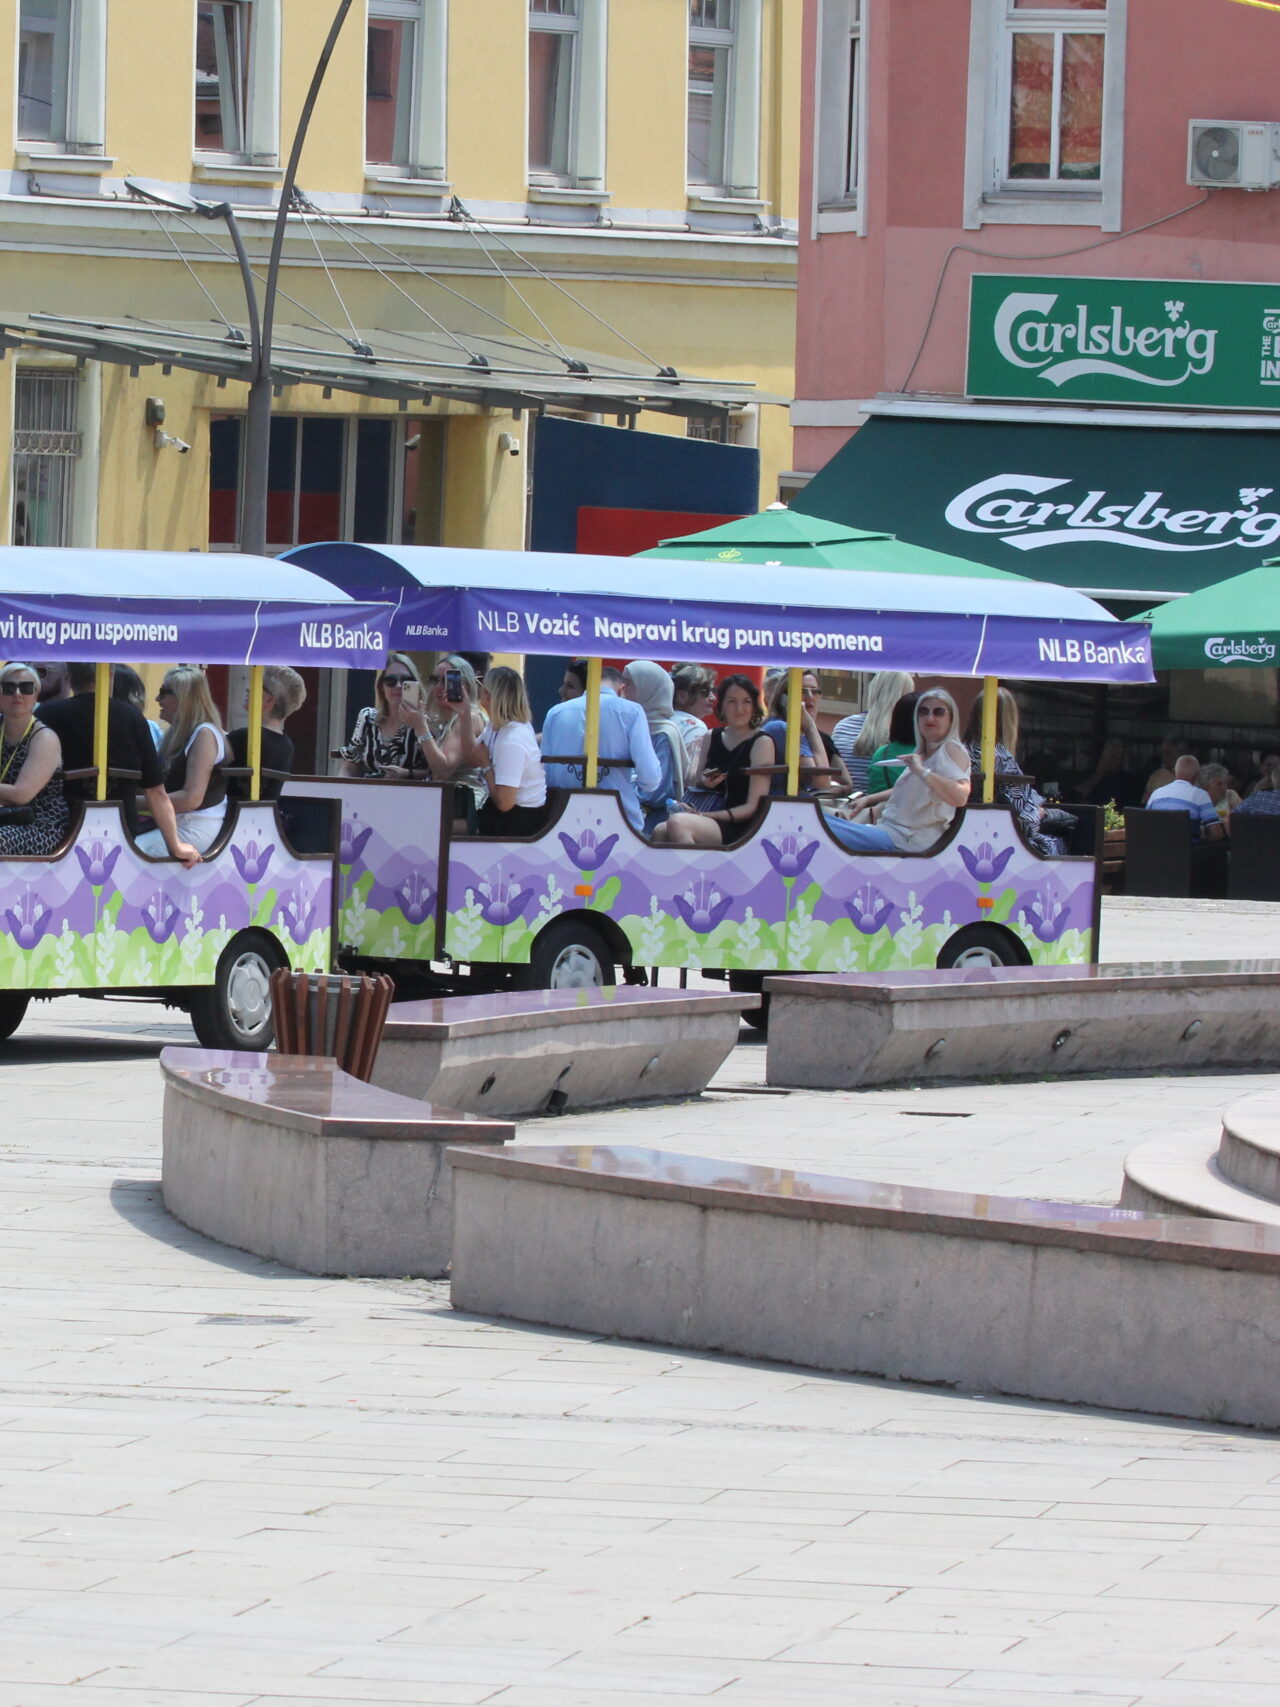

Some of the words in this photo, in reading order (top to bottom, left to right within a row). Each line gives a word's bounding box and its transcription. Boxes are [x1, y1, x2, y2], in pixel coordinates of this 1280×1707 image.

[994, 292, 1218, 387] Carlsberg
[944, 474, 1280, 551] Carlsberg
[18, 617, 56, 644] krug
[60, 620, 92, 645] pun
[95, 621, 178, 645] uspomena
[300, 622, 332, 648] NLB
[335, 624, 384, 651] Banka
[405, 624, 422, 635] NLB
[422, 625, 448, 636] Banka
[478, 609, 520, 633] NLB
[524, 612, 580, 637] Vozić
[594, 616, 677, 643] Napravi
[682, 620, 730, 649] krug
[735, 628, 774, 649] pun
[778, 630, 883, 652] uspomena
[1038, 638, 1081, 662] NLB
[1084, 641, 1146, 665] Banka
[1204, 637, 1276, 664] Carlsberg
